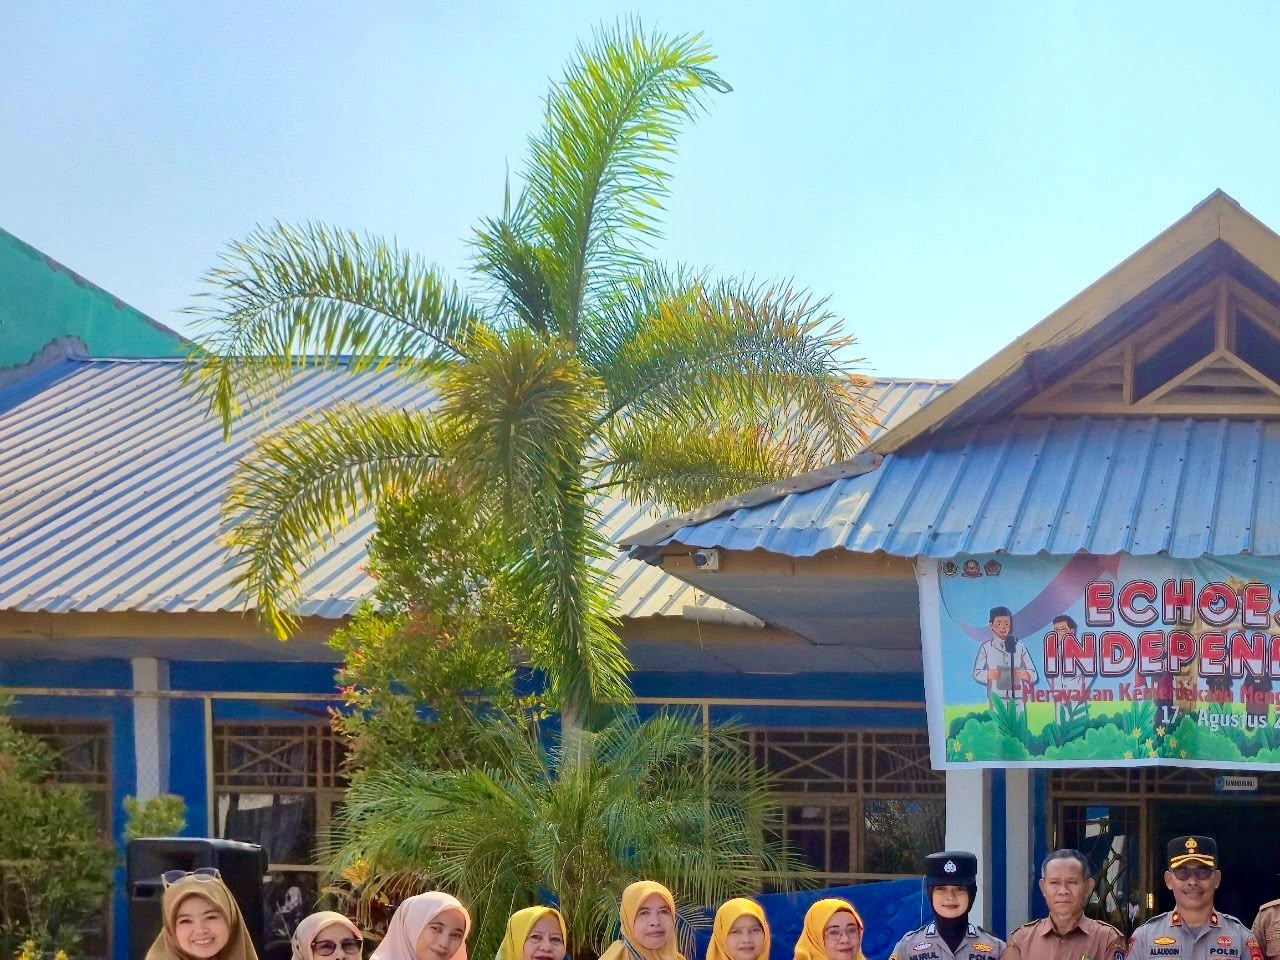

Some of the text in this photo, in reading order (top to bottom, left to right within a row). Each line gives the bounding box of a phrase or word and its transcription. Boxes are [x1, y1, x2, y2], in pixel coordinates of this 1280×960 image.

[1161, 705, 1180, 724] 17
[1197, 708, 1268, 731] Agustus
[1149, 948, 1238, 956] ALAUDDIN POLRI
